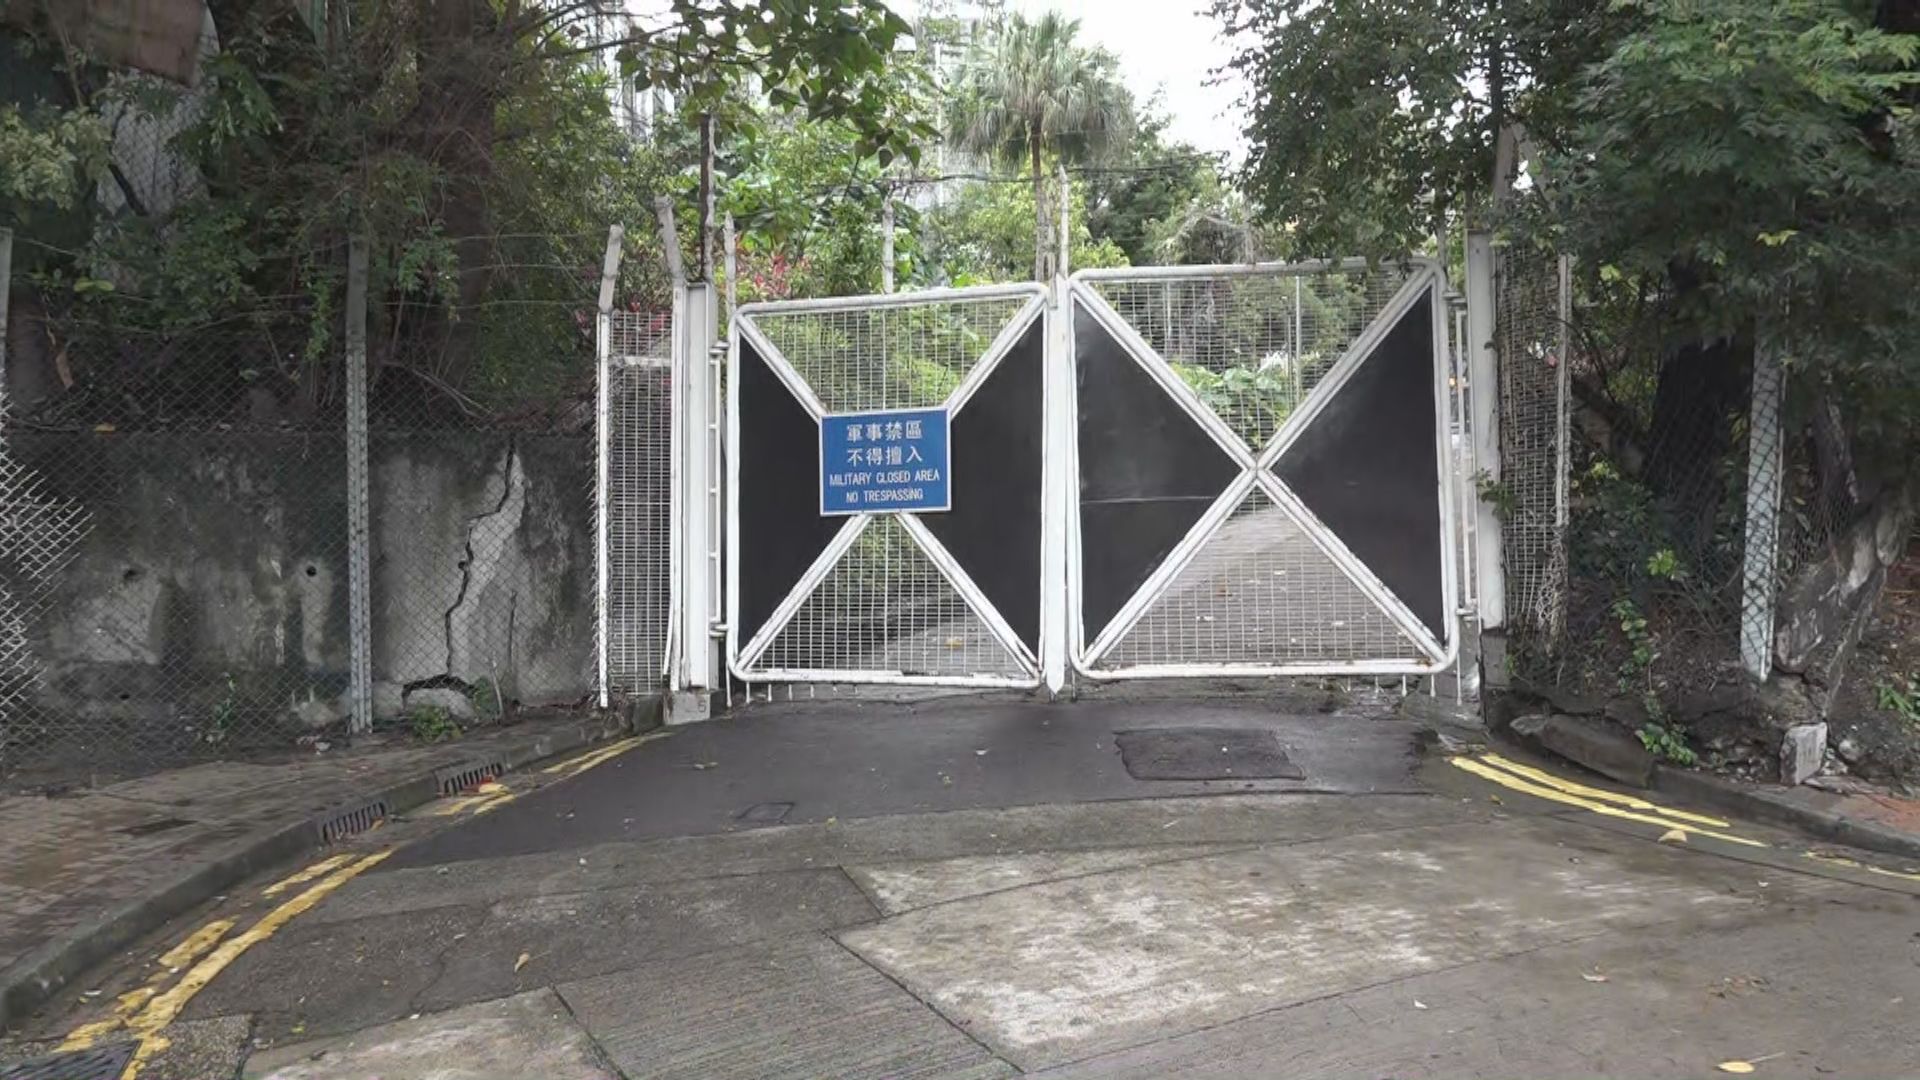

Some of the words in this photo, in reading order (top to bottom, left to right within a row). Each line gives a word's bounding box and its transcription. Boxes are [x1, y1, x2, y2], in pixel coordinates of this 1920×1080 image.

[847, 421, 922, 442] 軍事禁區
[847, 446, 922, 467] 不得擅入
[829, 472, 872, 486] MILITARY
[876, 470, 910, 483] CLOSED
[914, 468, 940, 481] AREA
[846, 491, 858, 503] NO
[864, 488, 923, 502] TRESPASSING
